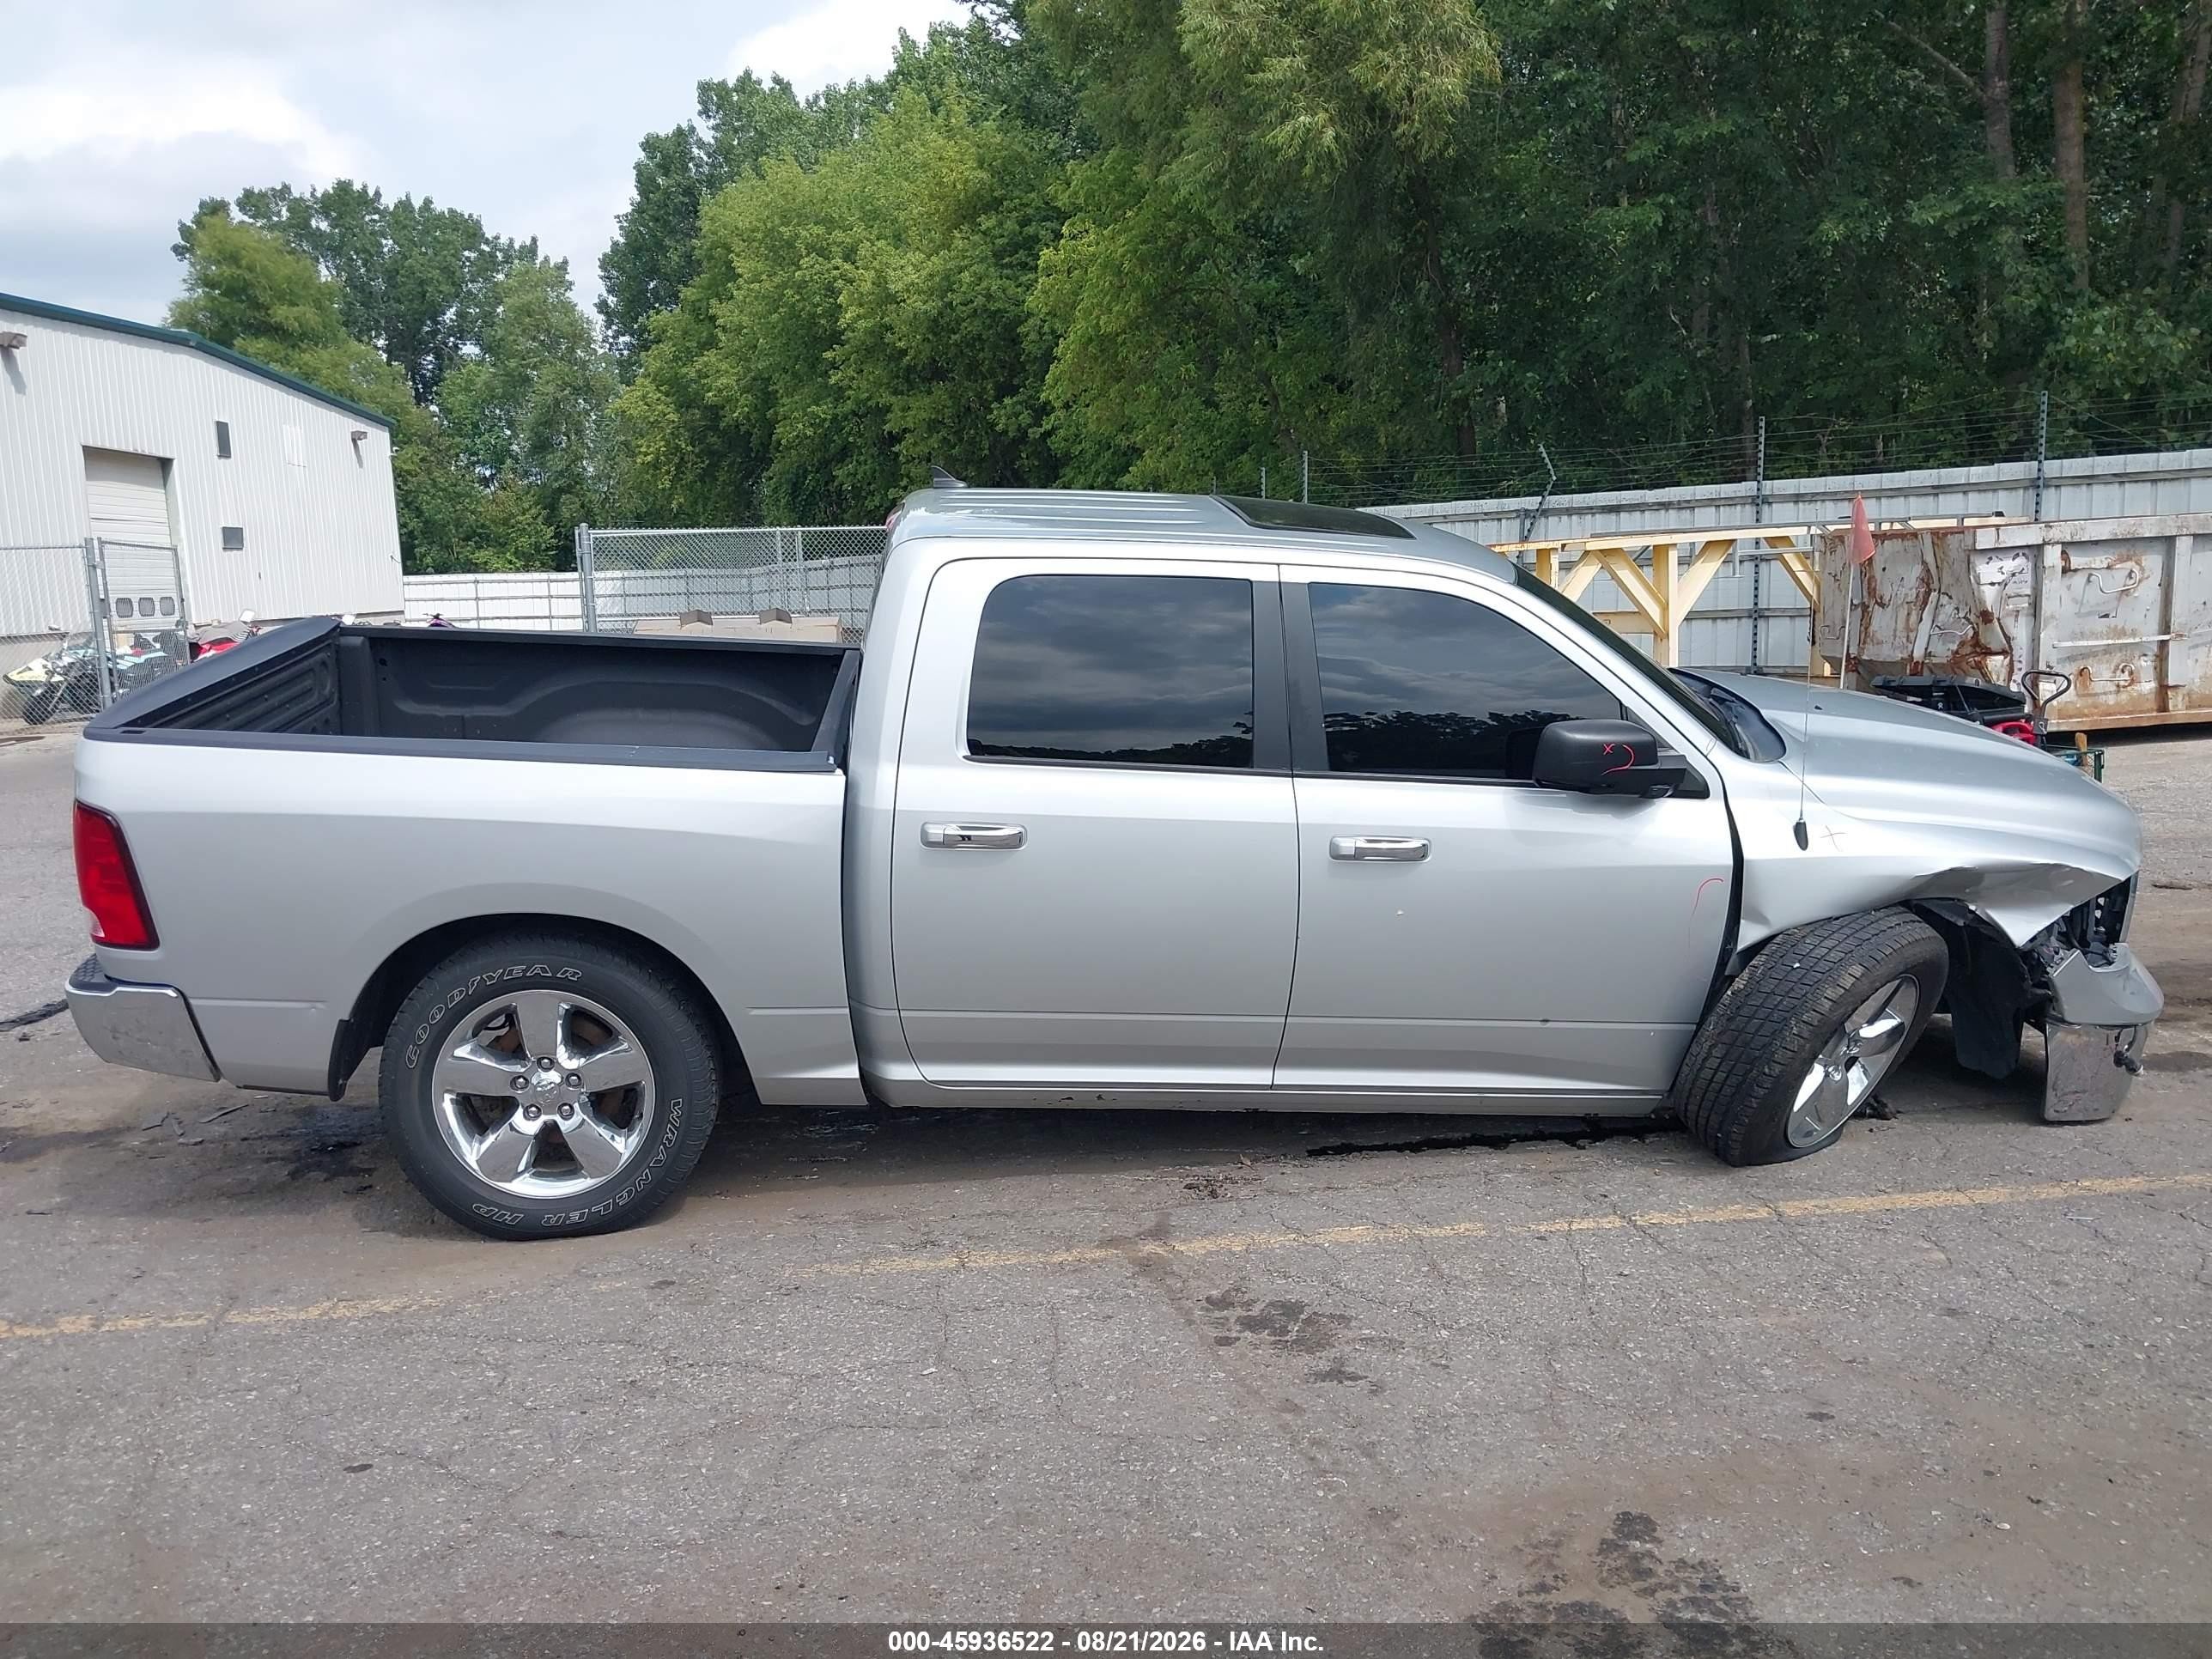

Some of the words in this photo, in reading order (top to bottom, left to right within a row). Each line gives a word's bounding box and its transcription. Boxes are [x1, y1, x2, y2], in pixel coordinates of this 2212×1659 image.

[406, 964, 583, 1070] GOODYEAR
[472, 1202, 525, 1225] HP
[541, 1097, 684, 1227] WRANGLER
